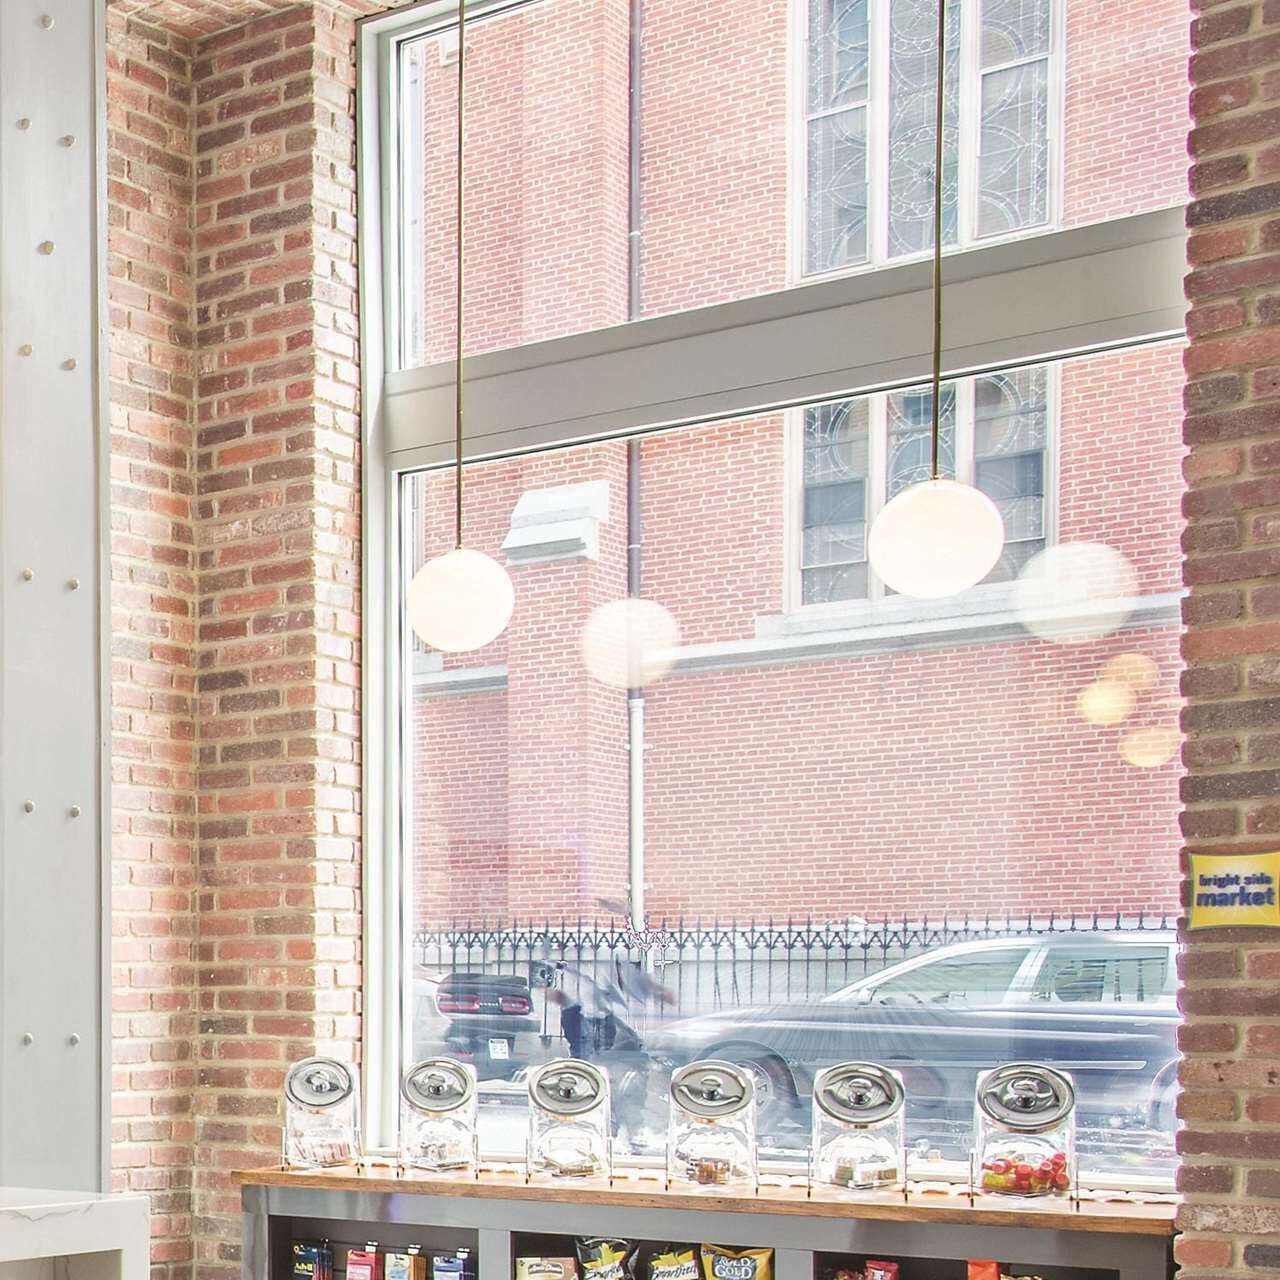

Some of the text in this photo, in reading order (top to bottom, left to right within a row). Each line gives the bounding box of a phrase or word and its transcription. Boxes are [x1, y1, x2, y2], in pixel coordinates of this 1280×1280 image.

[1199, 873, 1240, 888] bright
[1196, 886, 1275, 906] market
[714, 1264, 753, 1280] GOLD
